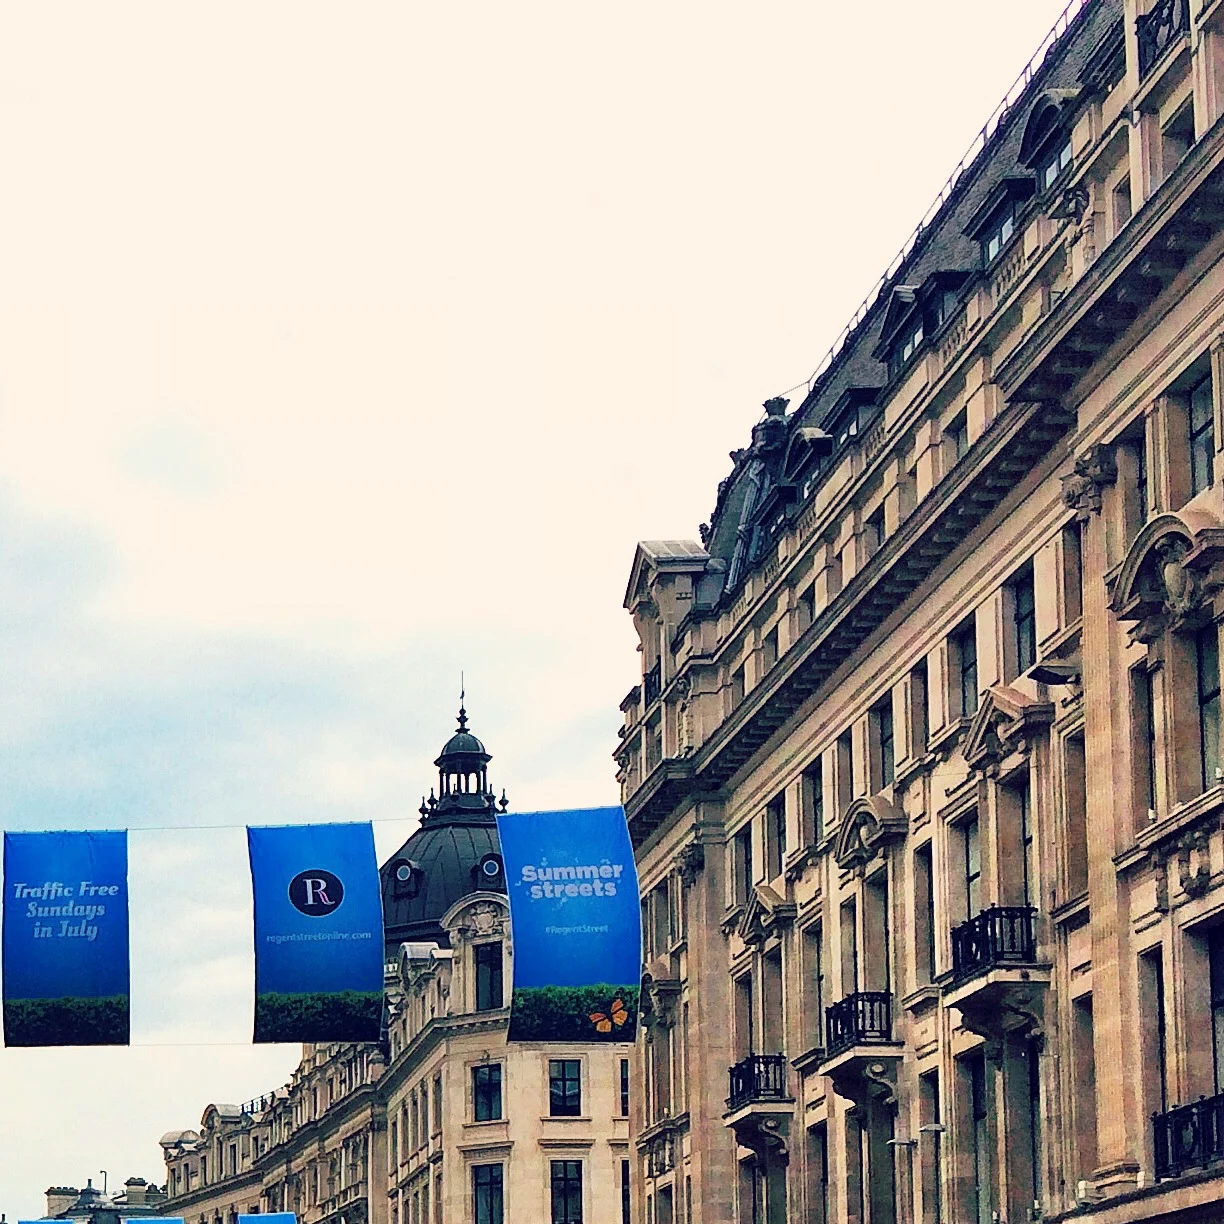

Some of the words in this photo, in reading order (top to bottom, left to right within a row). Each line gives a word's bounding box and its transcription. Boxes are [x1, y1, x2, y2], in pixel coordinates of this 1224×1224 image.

[521, 864, 623, 882] Summer
[13, 881, 74, 900] Traffic
[78, 881, 120, 897] Free
[302, 878, 336, 906] R
[530, 878, 617, 899] streets
[26, 900, 106, 920] Sundays
[34, 921, 52, 938] in
[57, 919, 98, 941] July
